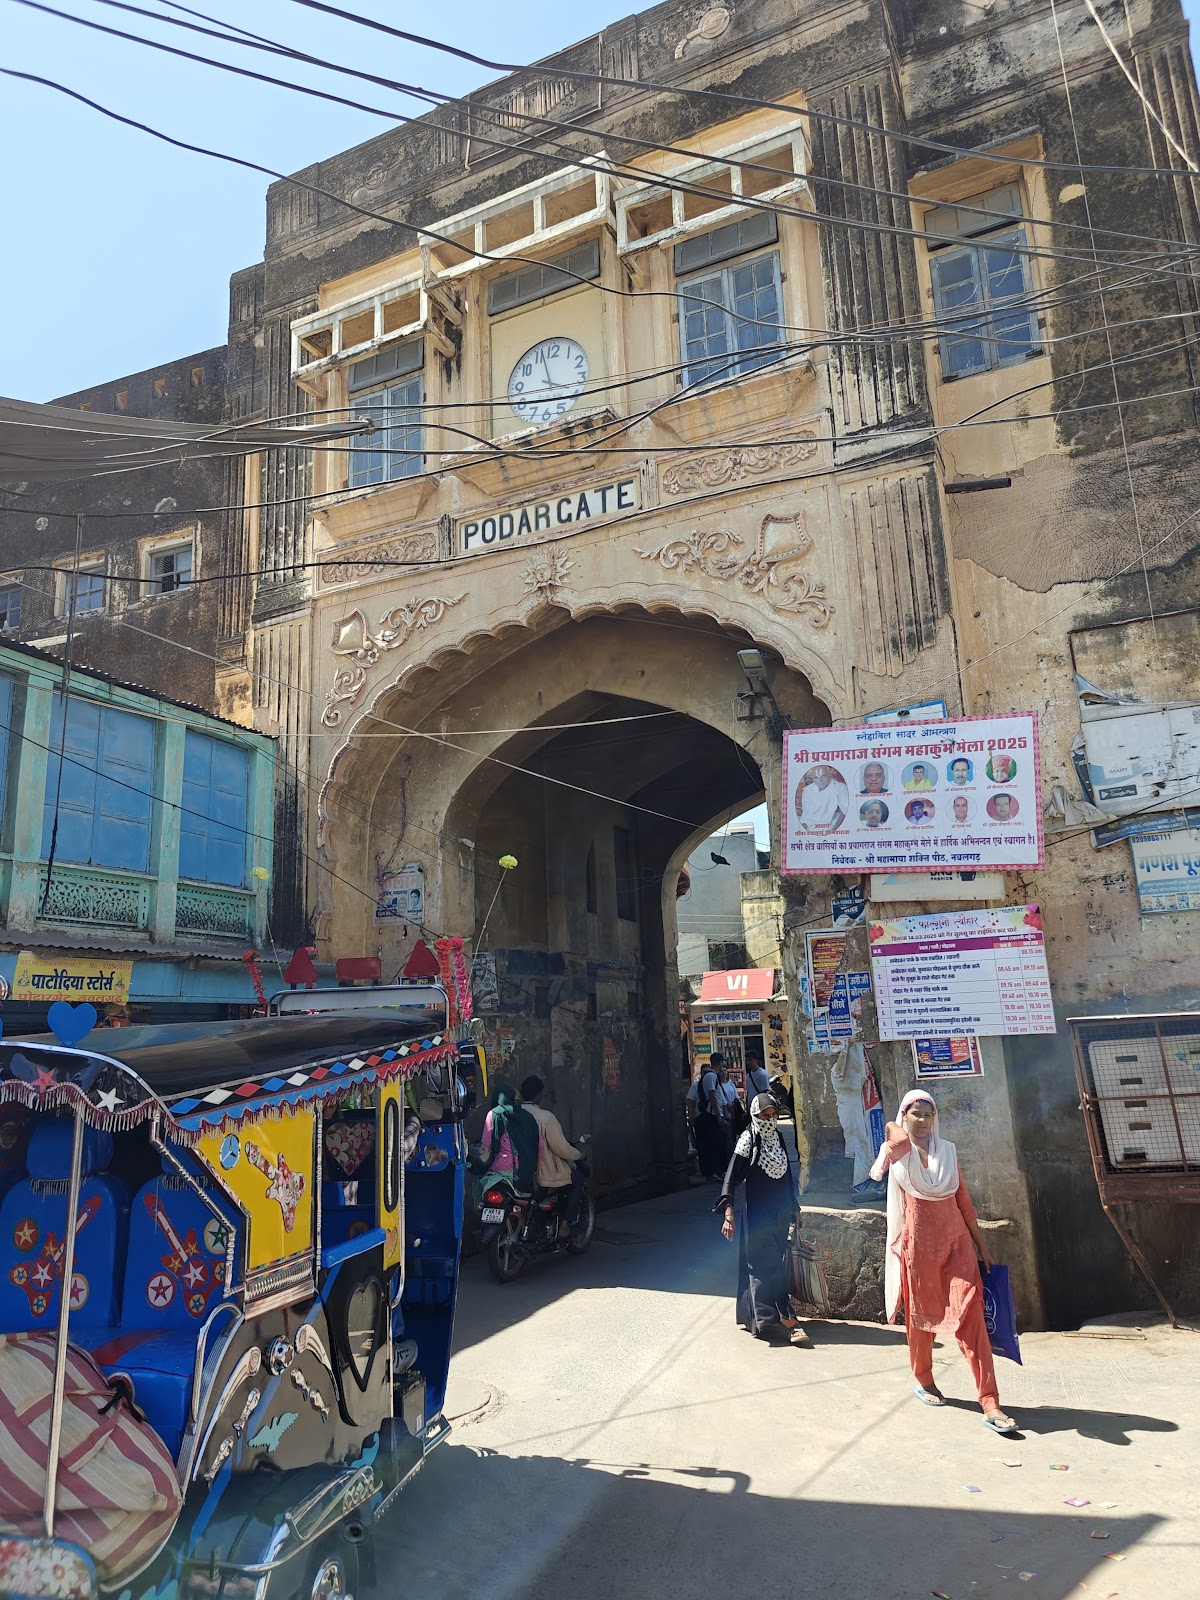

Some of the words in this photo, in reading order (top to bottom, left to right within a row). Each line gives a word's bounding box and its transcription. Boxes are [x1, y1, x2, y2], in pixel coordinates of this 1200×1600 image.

[547, 344, 560, 359] 12
[574, 355, 584, 369] 2
[522, 363, 532, 377] 10
[515, 381, 524, 393] 9
[529, 407, 539, 420] 7
[541, 408, 552, 421] 6
[556, 402, 567, 415] 5
[896, 730, 916, 738] सादर
[793, 750, 810, 763] श्री
[812, 749, 868, 763] प्रयागराज
[871, 744, 902, 758] संगम
[905, 740, 953, 759] महाकुंभ
[956, 739, 984, 753] मेला
[987, 736, 1027, 751] 2025
[1109, 790, 1125, 798] Google
[1125, 789, 1135, 797] Play
[790, 840, 803, 851] सभी
[805, 840, 815, 850] क्षेत्र
[816, 839, 837, 851] वासियों
[838, 841, 847, 850] का
[848, 841, 875, 850] प्रयागराज
[877, 838, 892, 849] संगम
[921, 837, 931, 847] मेले
[940, 835, 959, 847] हार्दिक
[961, 835, 991, 846] अभिनन्दन
[993, 834, 1002, 846] एवं
[1004, 836, 1026, 845] स्वागत
[832, 854, 856, 864] निवेदक
[865, 853, 875, 864] श्री
[877, 855, 906, 863] महामाया
[909, 852, 930, 862] शक्ति
[932, 852, 949, 863] पीठ,
[951, 853, 981, 863] नवलगढ़
[31, 968, 85, 990] पाटोदिया
[86, 970, 115, 991] स्टोर्स
